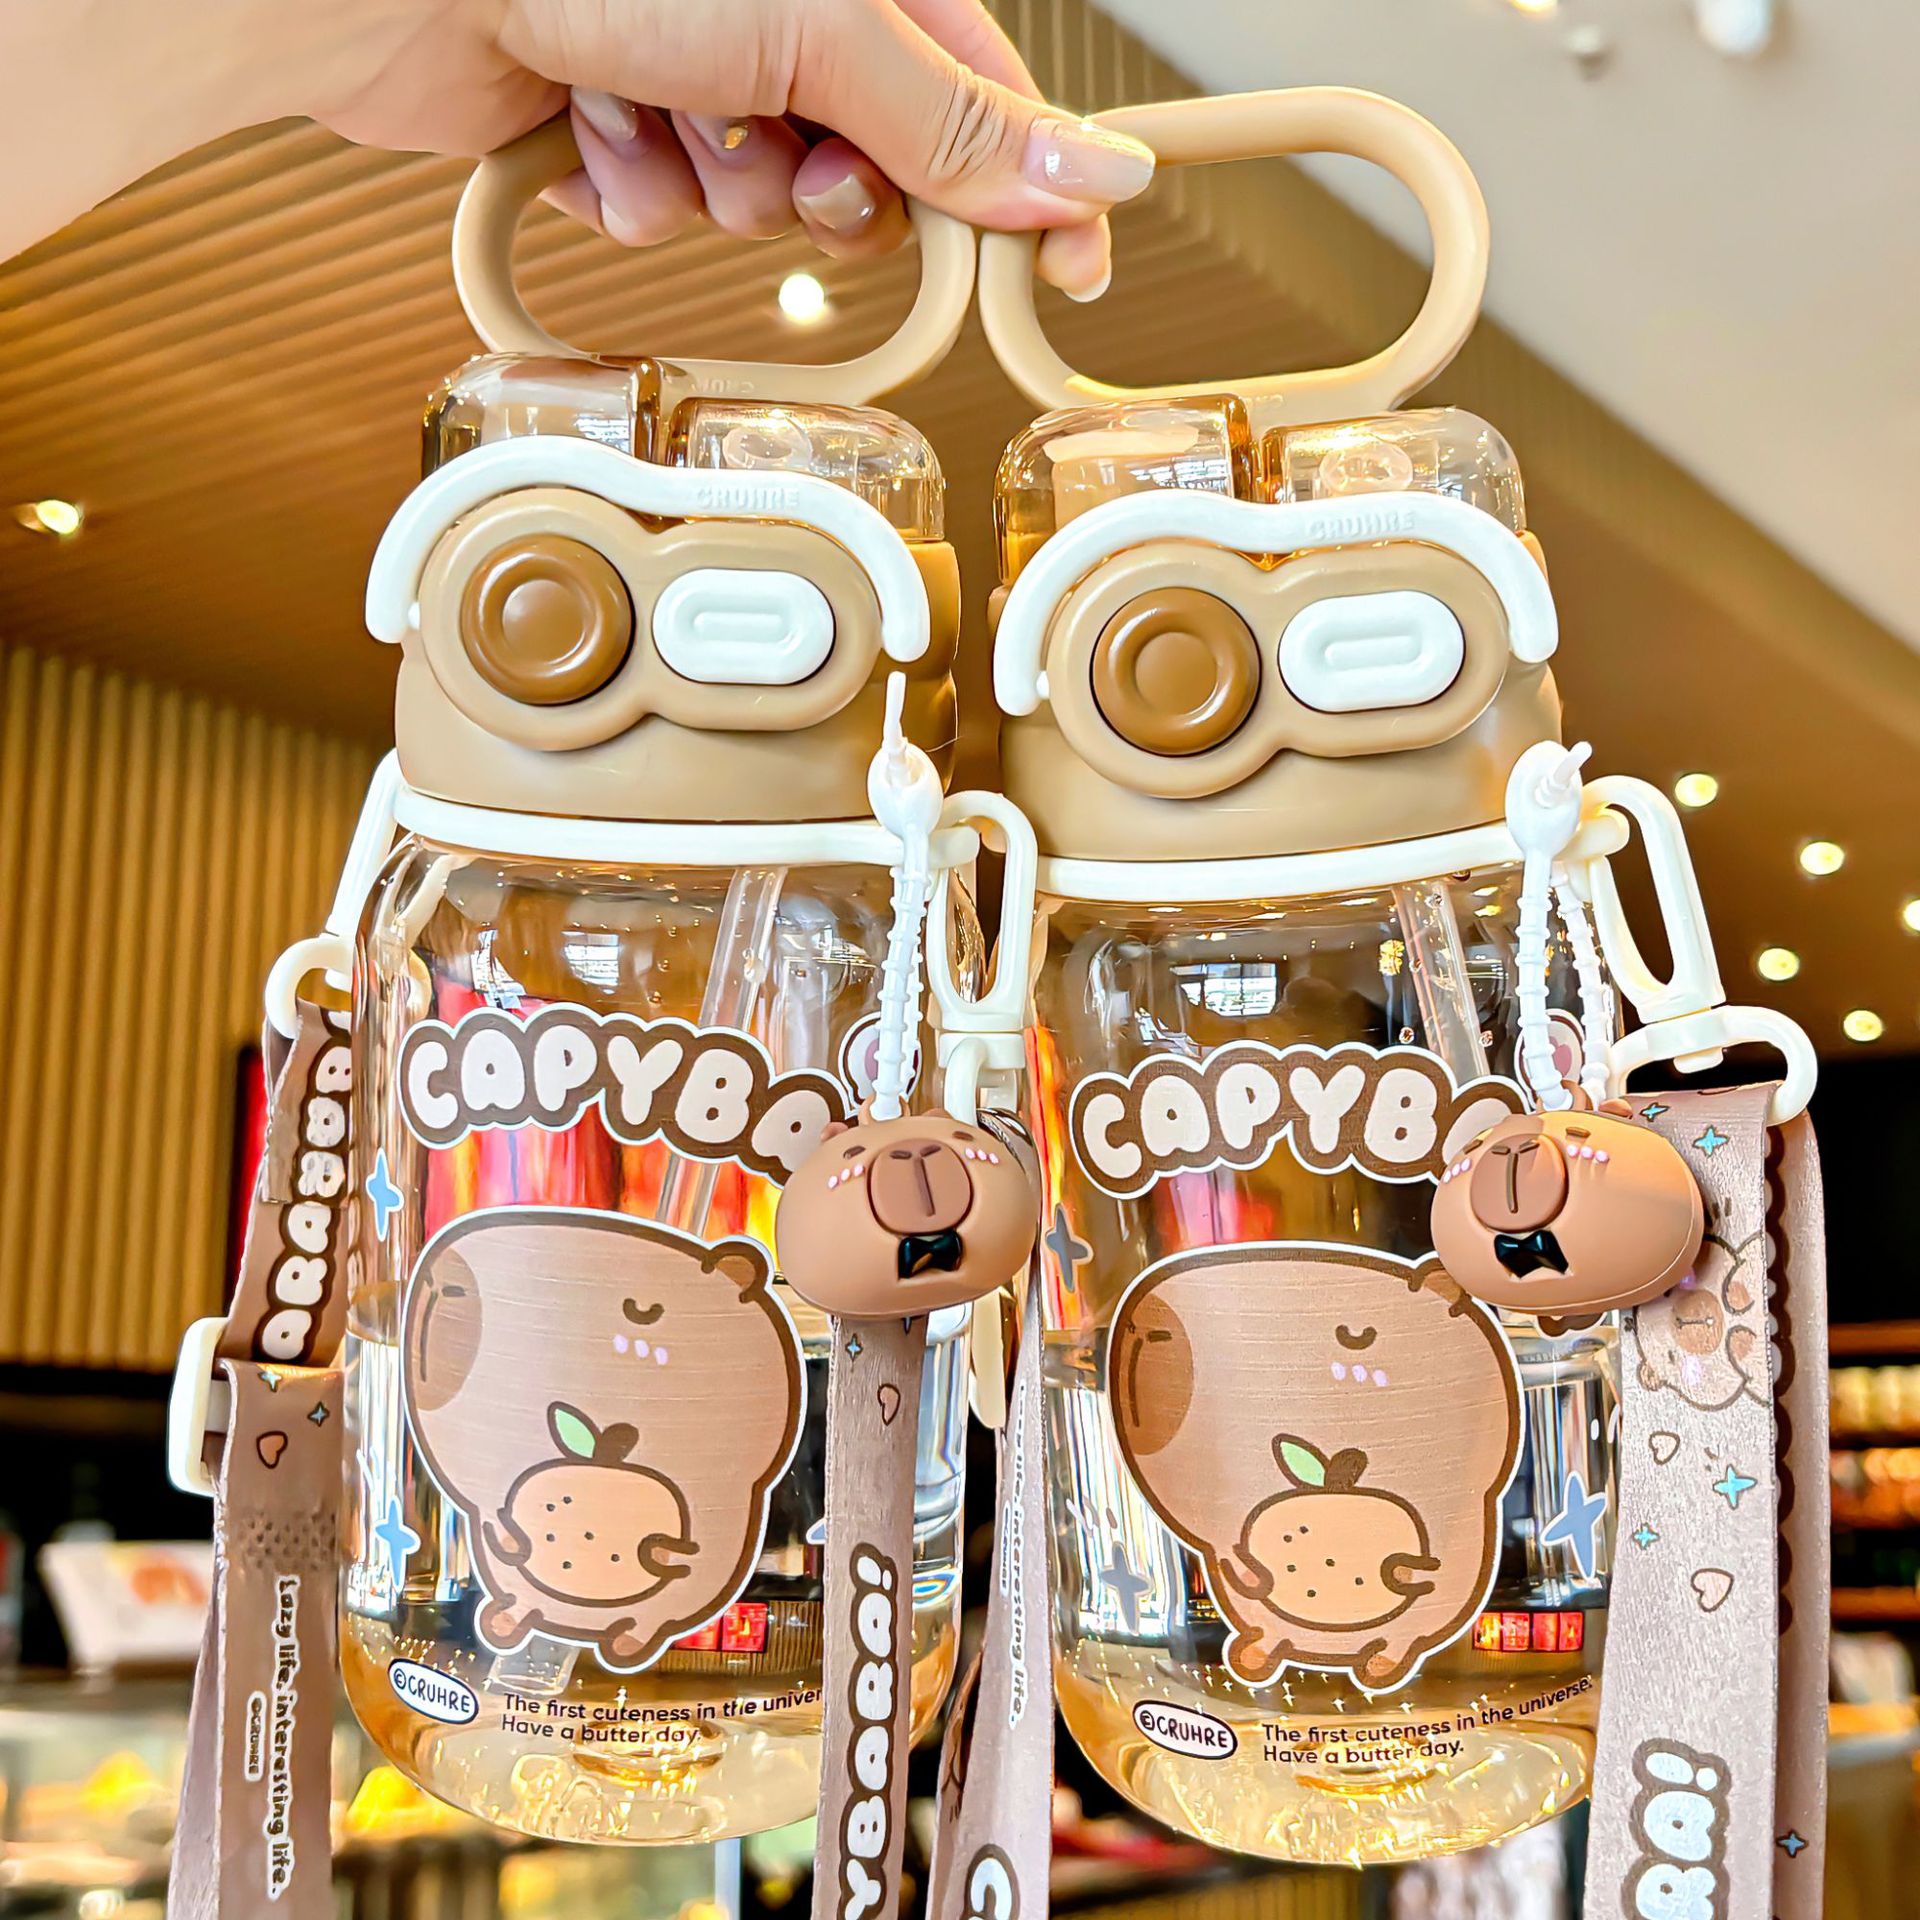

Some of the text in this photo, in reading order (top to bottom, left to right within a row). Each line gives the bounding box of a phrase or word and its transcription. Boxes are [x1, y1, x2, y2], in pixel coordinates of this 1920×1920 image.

[275, 1579, 298, 1639] Lazy
[504, 1692, 541, 1714] The
[548, 1699, 586, 1719] first
[593, 1705, 691, 1722] cuteness
[696, 1703, 715, 1719] in
[722, 1699, 758, 1718] the
[502, 1714, 554, 1738] Have
[560, 1727, 575, 1741] a
[581, 1724, 647, 1743] butter
[1261, 1723, 1302, 1742] The
[1308, 1726, 1348, 1744] first
[1355, 1720, 1451, 1743] cuteness
[1456, 1713, 1475, 1731] in
[1481, 1707, 1514, 1725] the
[266, 1693, 297, 1837] interesting
[1263, 1738, 1464, 1764] Have a butter day.
